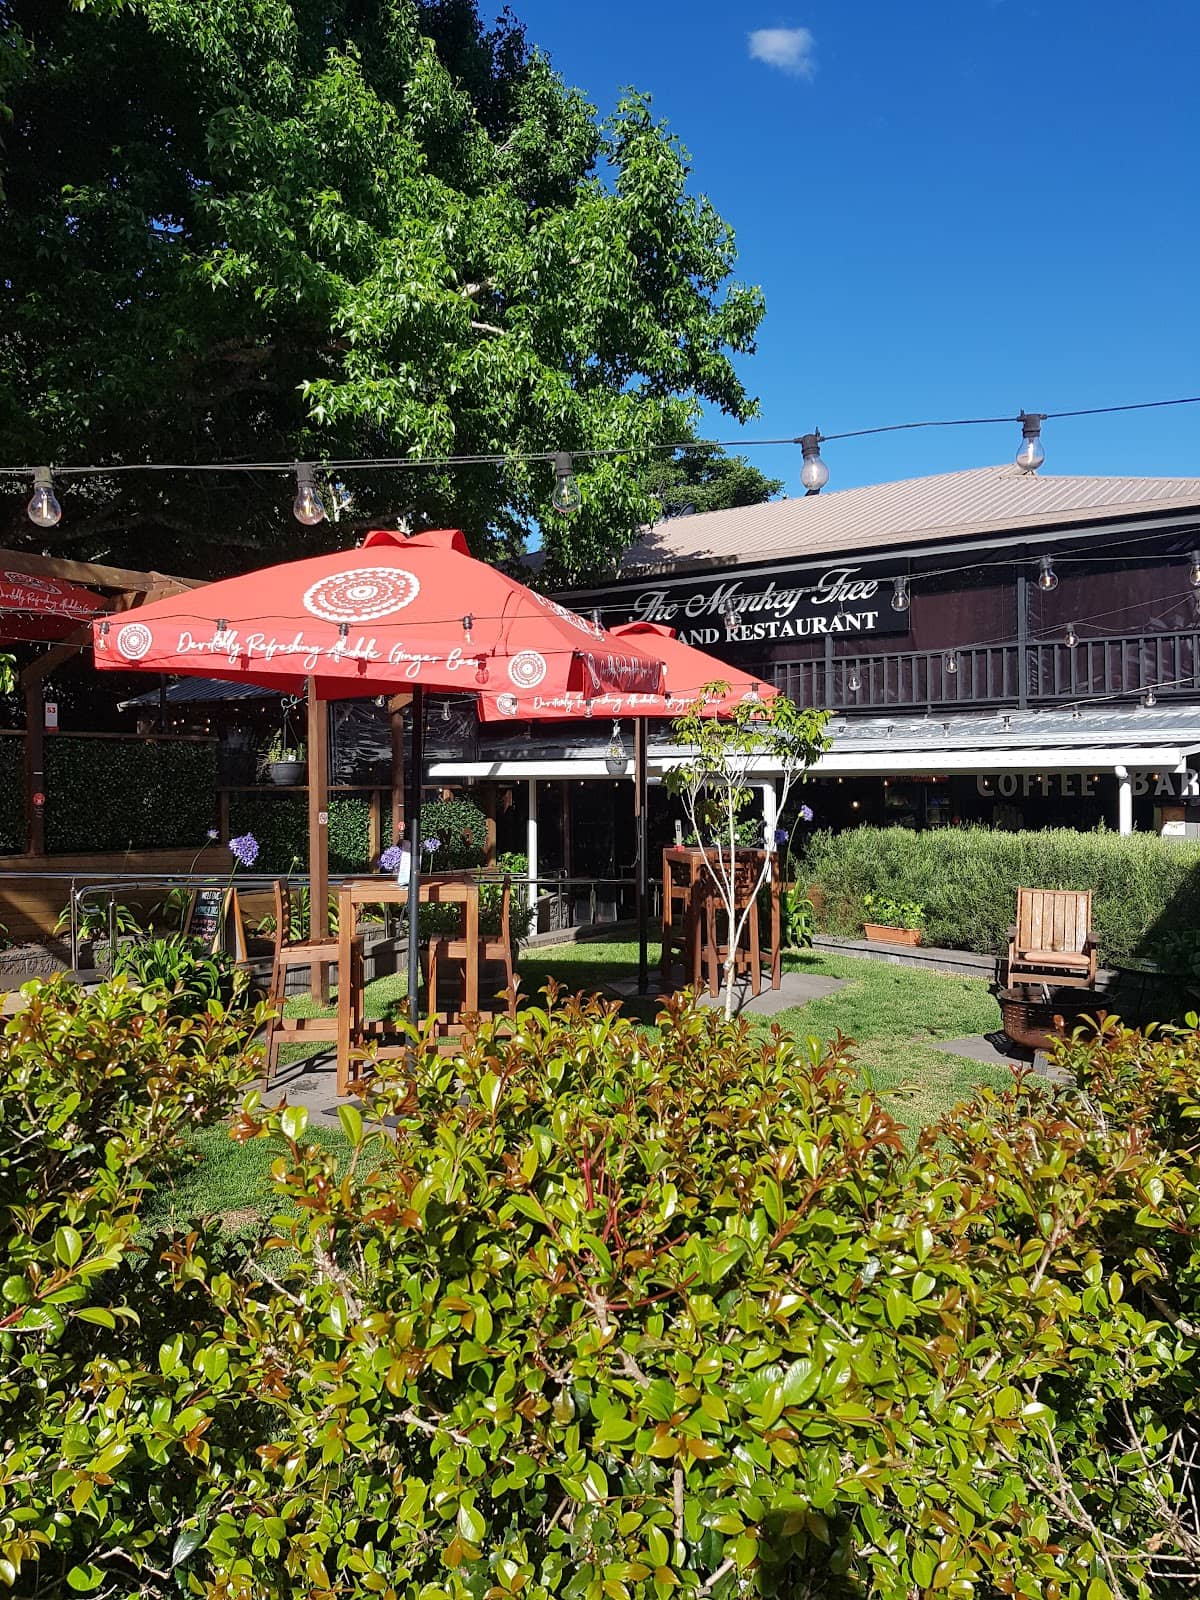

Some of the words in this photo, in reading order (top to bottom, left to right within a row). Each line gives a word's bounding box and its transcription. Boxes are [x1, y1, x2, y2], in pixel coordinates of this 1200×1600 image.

[628, 590, 679, 622] The
[811, 567, 879, 604] Tree
[678, 627, 720, 645] AND
[726, 611, 879, 642] RESTAURANT
[246, 632, 323, 670] Refreshing
[388, 643, 443, 678] Ginger
[446, 648, 486, 671] Beer
[976, 770, 1096, 797] COFFEE
[1130, 768, 1199, 796] BAR
